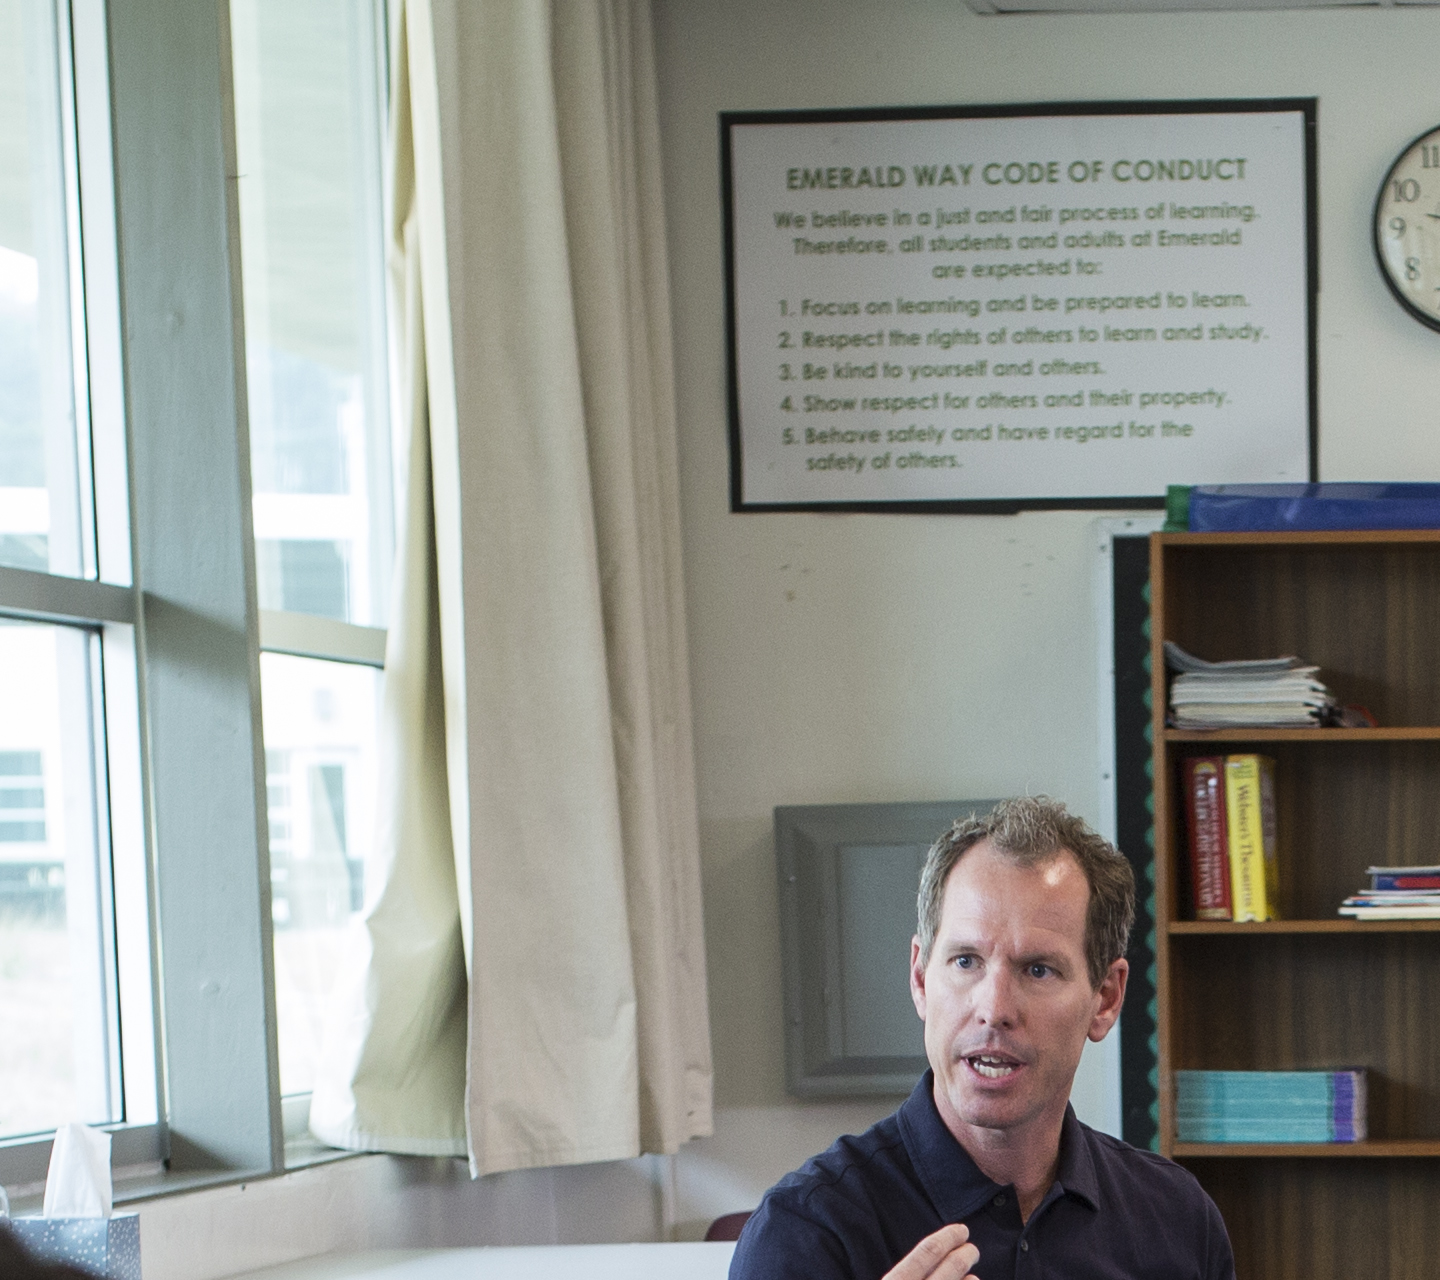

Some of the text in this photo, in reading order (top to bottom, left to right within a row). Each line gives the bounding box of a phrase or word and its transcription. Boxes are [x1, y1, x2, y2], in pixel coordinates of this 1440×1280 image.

[1422, 144, 1440, 169] 11
[787, 158, 1247, 189] EMERALD WAY CODE OF CONDUCT
[1393, 179, 1421, 202] 10
[774, 202, 1260, 228] We believe in a just and fair process of learning.
[899, 236, 923, 252] all
[928, 234, 1012, 252] students
[1017, 231, 1057, 249] and
[1064, 231, 1125, 248] adults
[1131, 230, 1151, 247] at
[1158, 228, 1242, 246] Emerald
[1389, 217, 1407, 239] 9
[932, 265, 967, 279] are
[972, 258, 1071, 280] expected
[1404, 257, 1420, 280] 8
[802, 299, 859, 316] Focus
[865, 301, 893, 315] on
[897, 297, 980, 318] learning
[985, 294, 1026, 313] and
[1032, 294, 1059, 311] be
[1065, 292, 1161, 315] prepared
[1166, 291, 1186, 308] to
[802, 329, 884, 351] Respect
[889, 329, 921, 346] the
[926, 328, 980, 350] rights
[986, 327, 1007, 345] of
[1012, 326, 1073, 344] others
[1078, 325, 1099, 342] to
[1104, 324, 1156, 341] learn
[1163, 323, 1203, 341] and
[802, 362, 827, 380] Be
[833, 361, 877, 379] kind
[883, 361, 903, 378] to
[909, 359, 987, 381] yourself
[993, 358, 1033, 376] and
[803, 394, 856, 413] Show
[862, 392, 939, 414] respect
[944, 391, 969, 409] for
[975, 391, 1038, 409] others
[1043, 390, 1084, 408] and
[1089, 389, 1133, 407] their
[805, 426, 881, 444] Behave
[887, 424, 945, 445] safely
[951, 424, 993, 441] and
[998, 423, 1049, 441] have
[1055, 421, 1123, 443] regard
[1129, 421, 1155, 438] for
[1161, 421, 1194, 438] the
[806, 453, 865, 473] safety
[871, 451, 891, 470] of
